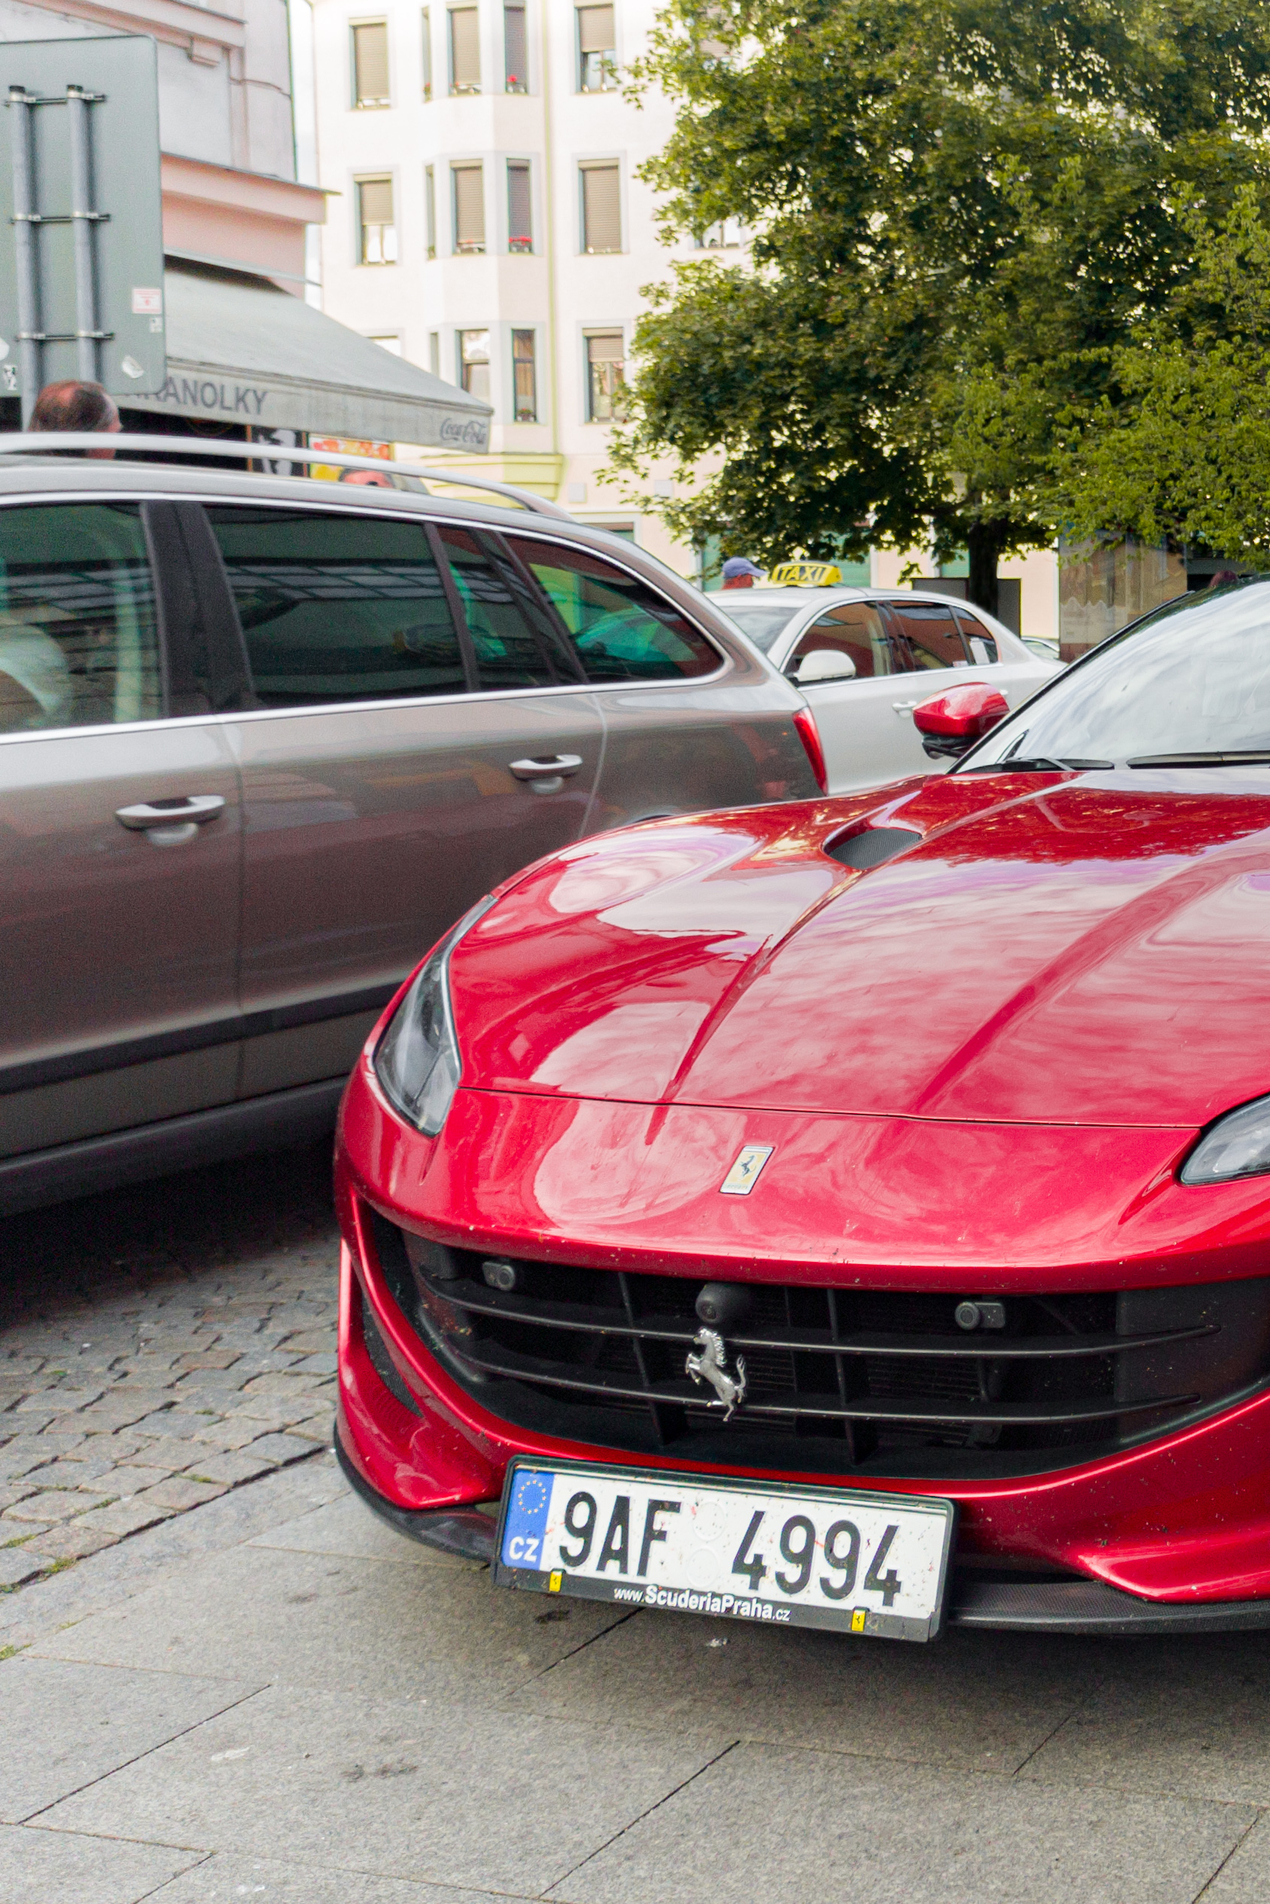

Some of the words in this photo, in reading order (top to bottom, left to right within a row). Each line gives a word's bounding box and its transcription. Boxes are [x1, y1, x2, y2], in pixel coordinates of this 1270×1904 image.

[136, 376, 268, 415] ANOLKY
[779, 565, 824, 581] TAXI
[508, 1535, 538, 1562] CZ
[558, 1491, 682, 1578] 9AF
[731, 1510, 903, 1608] 4994
[613, 1583, 791, 1622] www.ScuderiaPraha.cz
